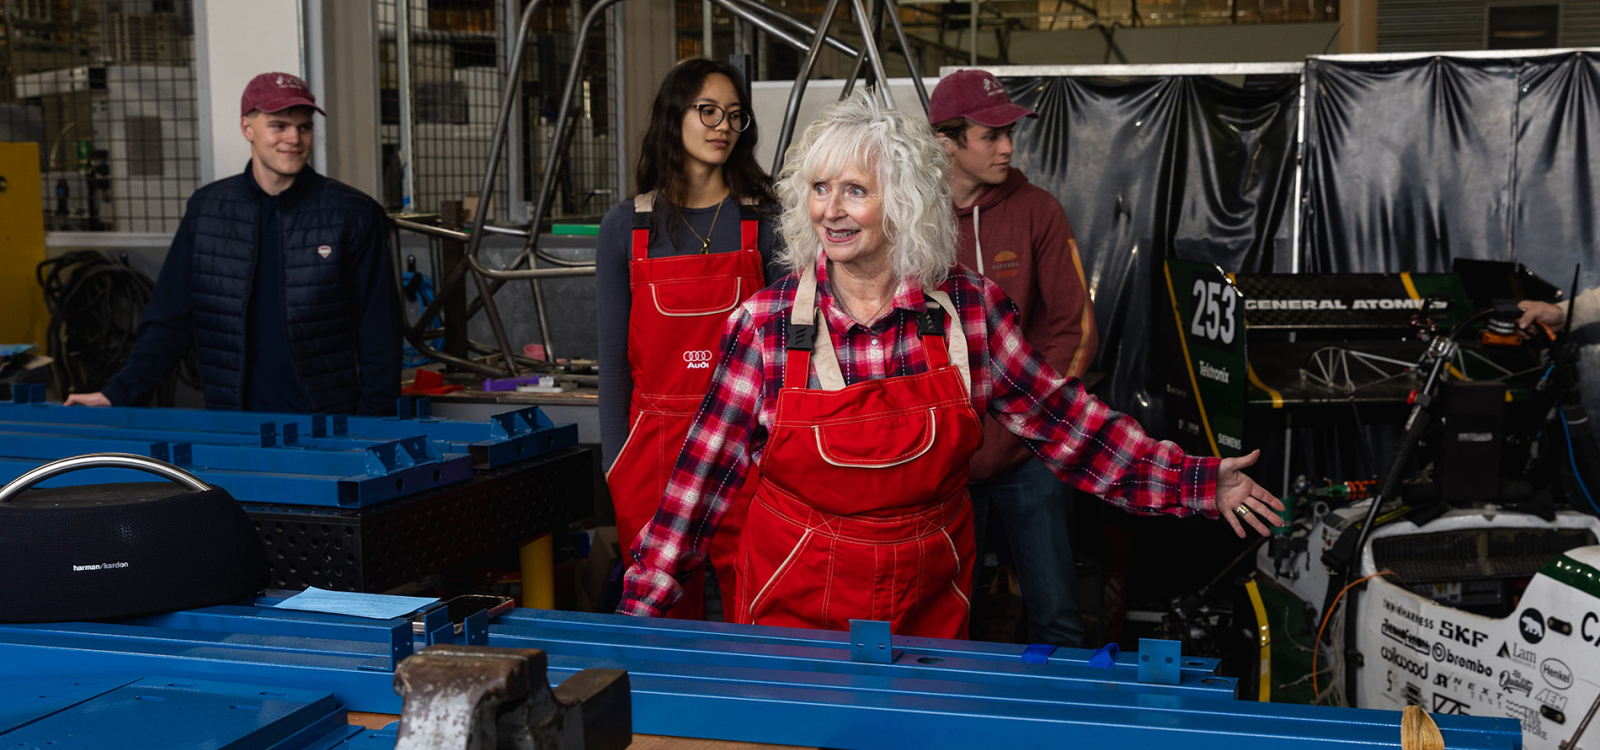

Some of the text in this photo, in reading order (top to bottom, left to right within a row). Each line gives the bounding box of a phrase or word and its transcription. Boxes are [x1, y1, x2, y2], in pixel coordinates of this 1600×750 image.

[1191, 279, 1236, 344] 253
[1245, 299, 1347, 310] GENERAL
[687, 361, 709, 369] Audi
[1199, 360, 1229, 384] Tektronix
[1217, 433, 1242, 450] SIEMENS
[73, 561, 128, 571] harman/kardon
[1438, 620, 1488, 648] SKF
[1381, 645, 1428, 680] wilwood
[1447, 648, 1492, 677] brembo
[1512, 642, 1537, 664] Lam
[1543, 664, 1571, 684] Henkel
[1534, 688, 1568, 713] AEM
